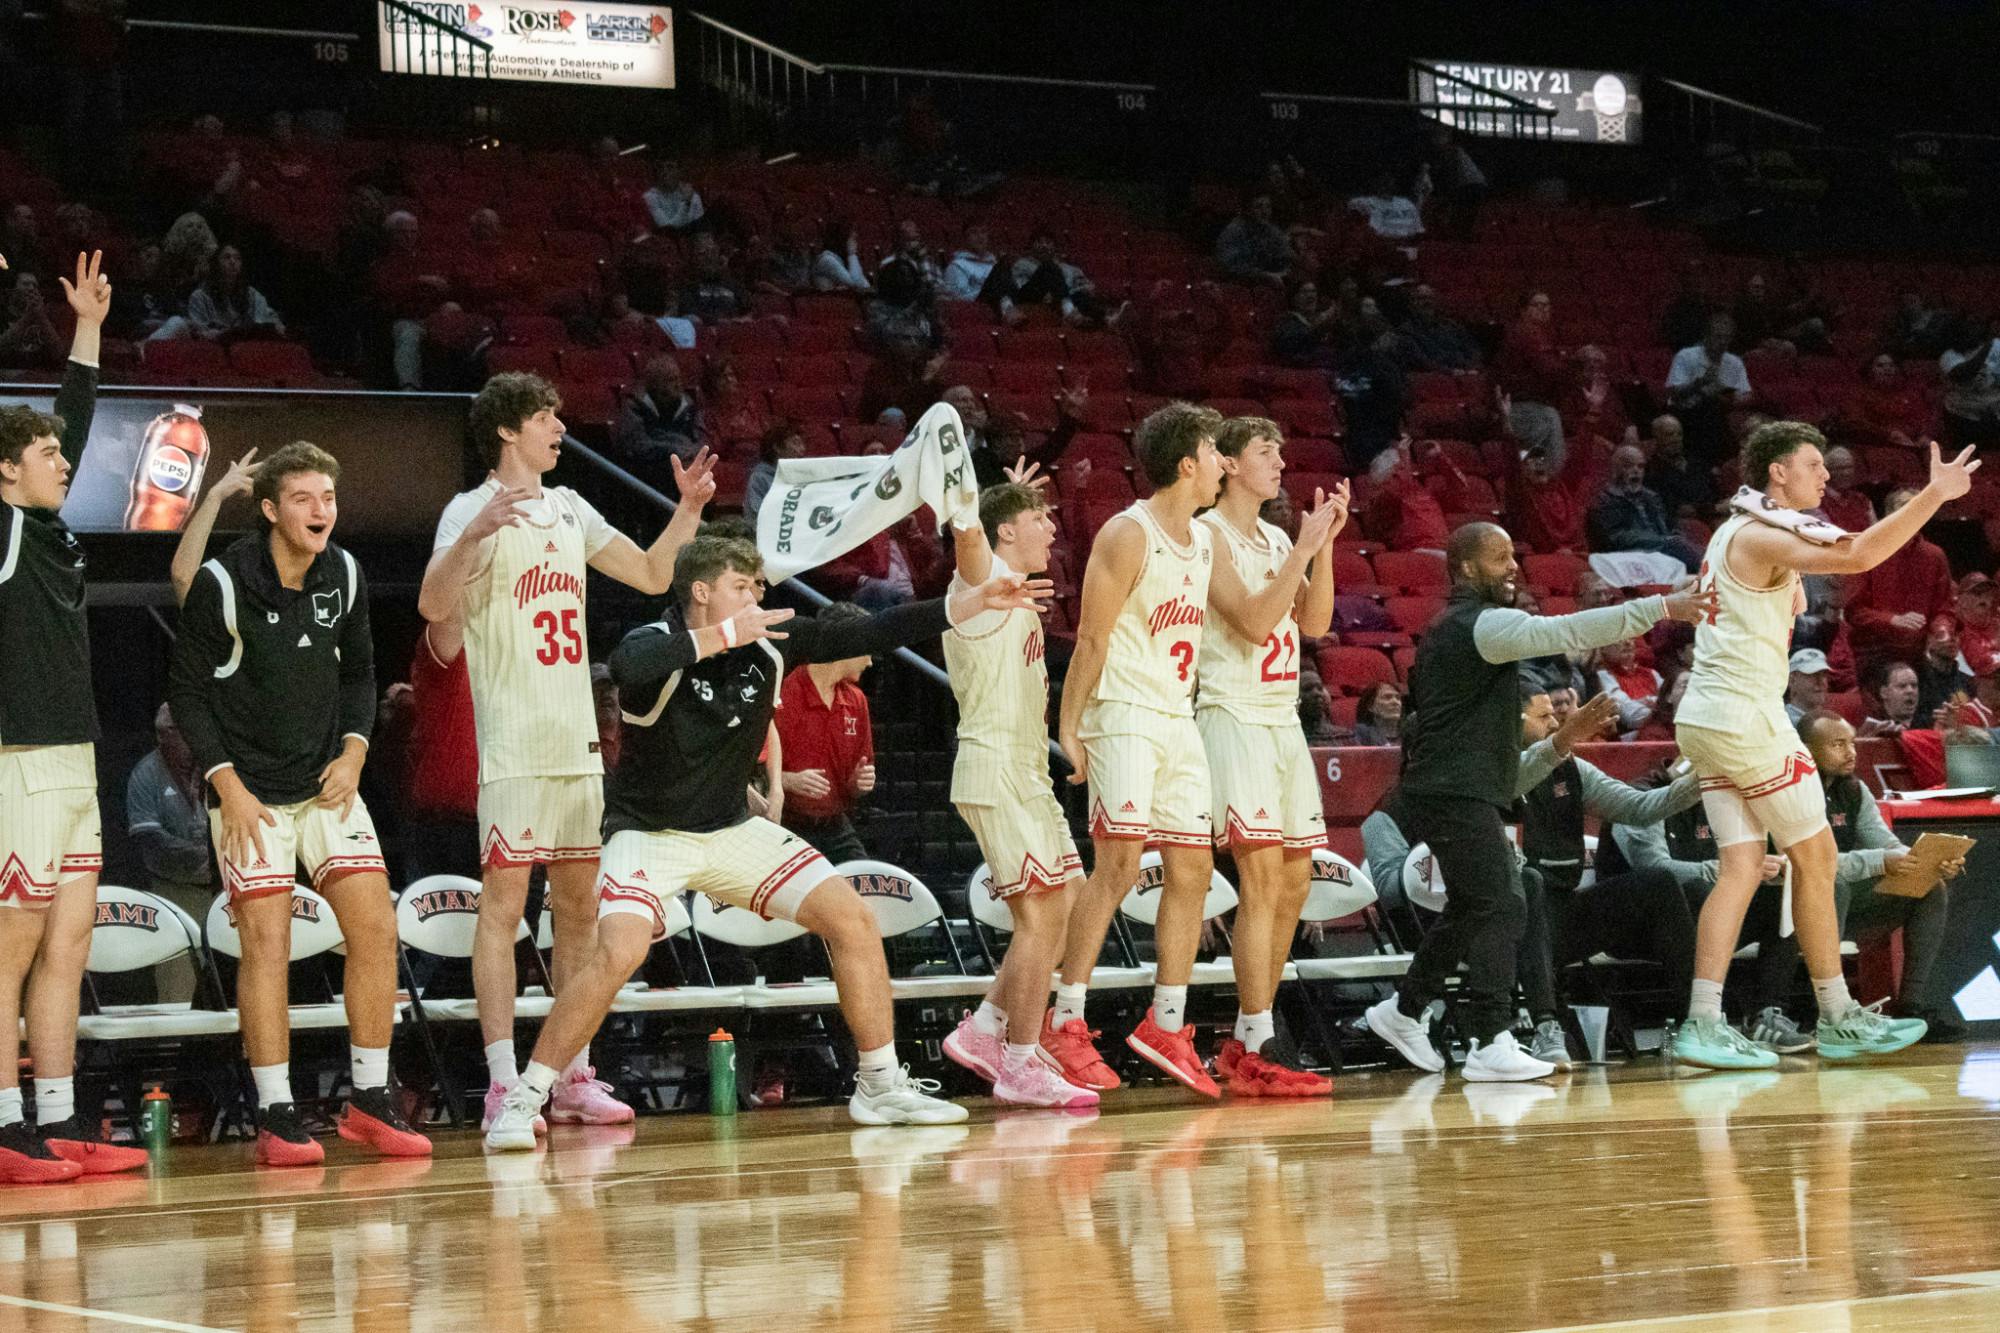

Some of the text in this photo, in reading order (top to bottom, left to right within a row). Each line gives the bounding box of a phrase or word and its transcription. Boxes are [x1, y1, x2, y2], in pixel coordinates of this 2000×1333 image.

[501, 5, 561, 36] ROSE
[586, 13, 652, 30] LARKIN
[588, 27, 651, 43] COBB
[314, 42, 348, 62] 105
[490, 54, 556, 66] Automotive
[560, 57, 620, 71] Dealership
[623, 61, 634, 71] of
[491, 65, 548, 78] University
[552, 68, 603, 81] Athletics
[1435, 65, 1573, 94] CENTURY 21
[1117, 95, 1146, 111] 104
[1271, 103, 1298, 120] 103
[513, 561, 584, 610] Miami
[533, 609, 583, 666] 35
[1327, 757, 1342, 782] 6
[845, 873, 913, 902] AMI
[95, 901, 159, 932] AMI
[410, 889, 481, 922] MIAM
